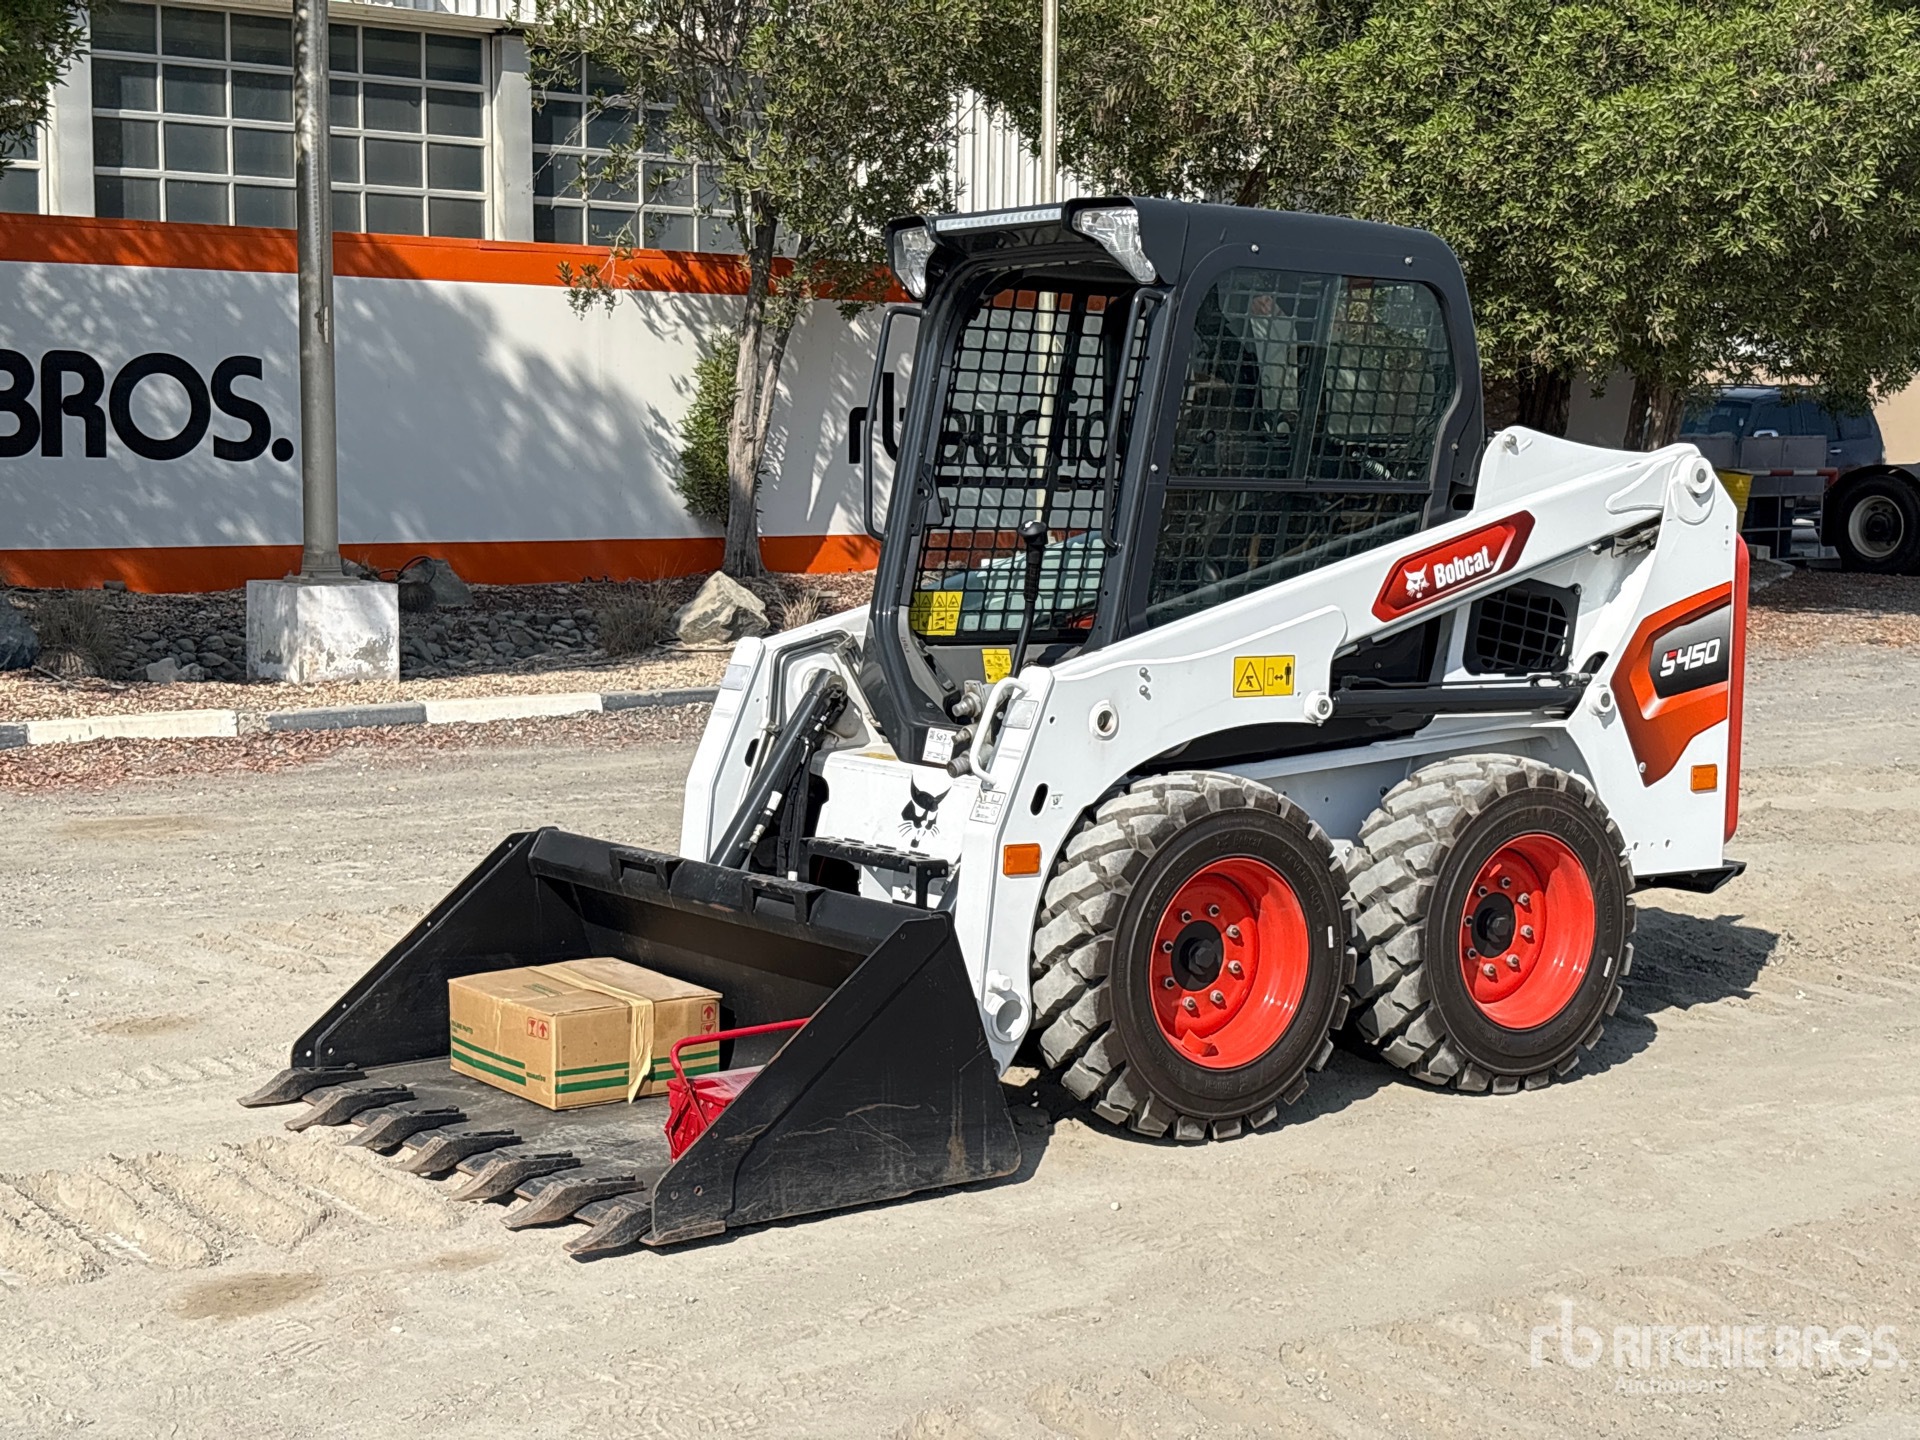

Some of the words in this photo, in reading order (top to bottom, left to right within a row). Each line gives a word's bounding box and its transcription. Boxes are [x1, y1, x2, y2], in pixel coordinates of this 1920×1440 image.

[0, 348, 294, 462] BROS.
[1433, 545, 1491, 589] Bobcat
[1660, 638, 1721, 678] S450
